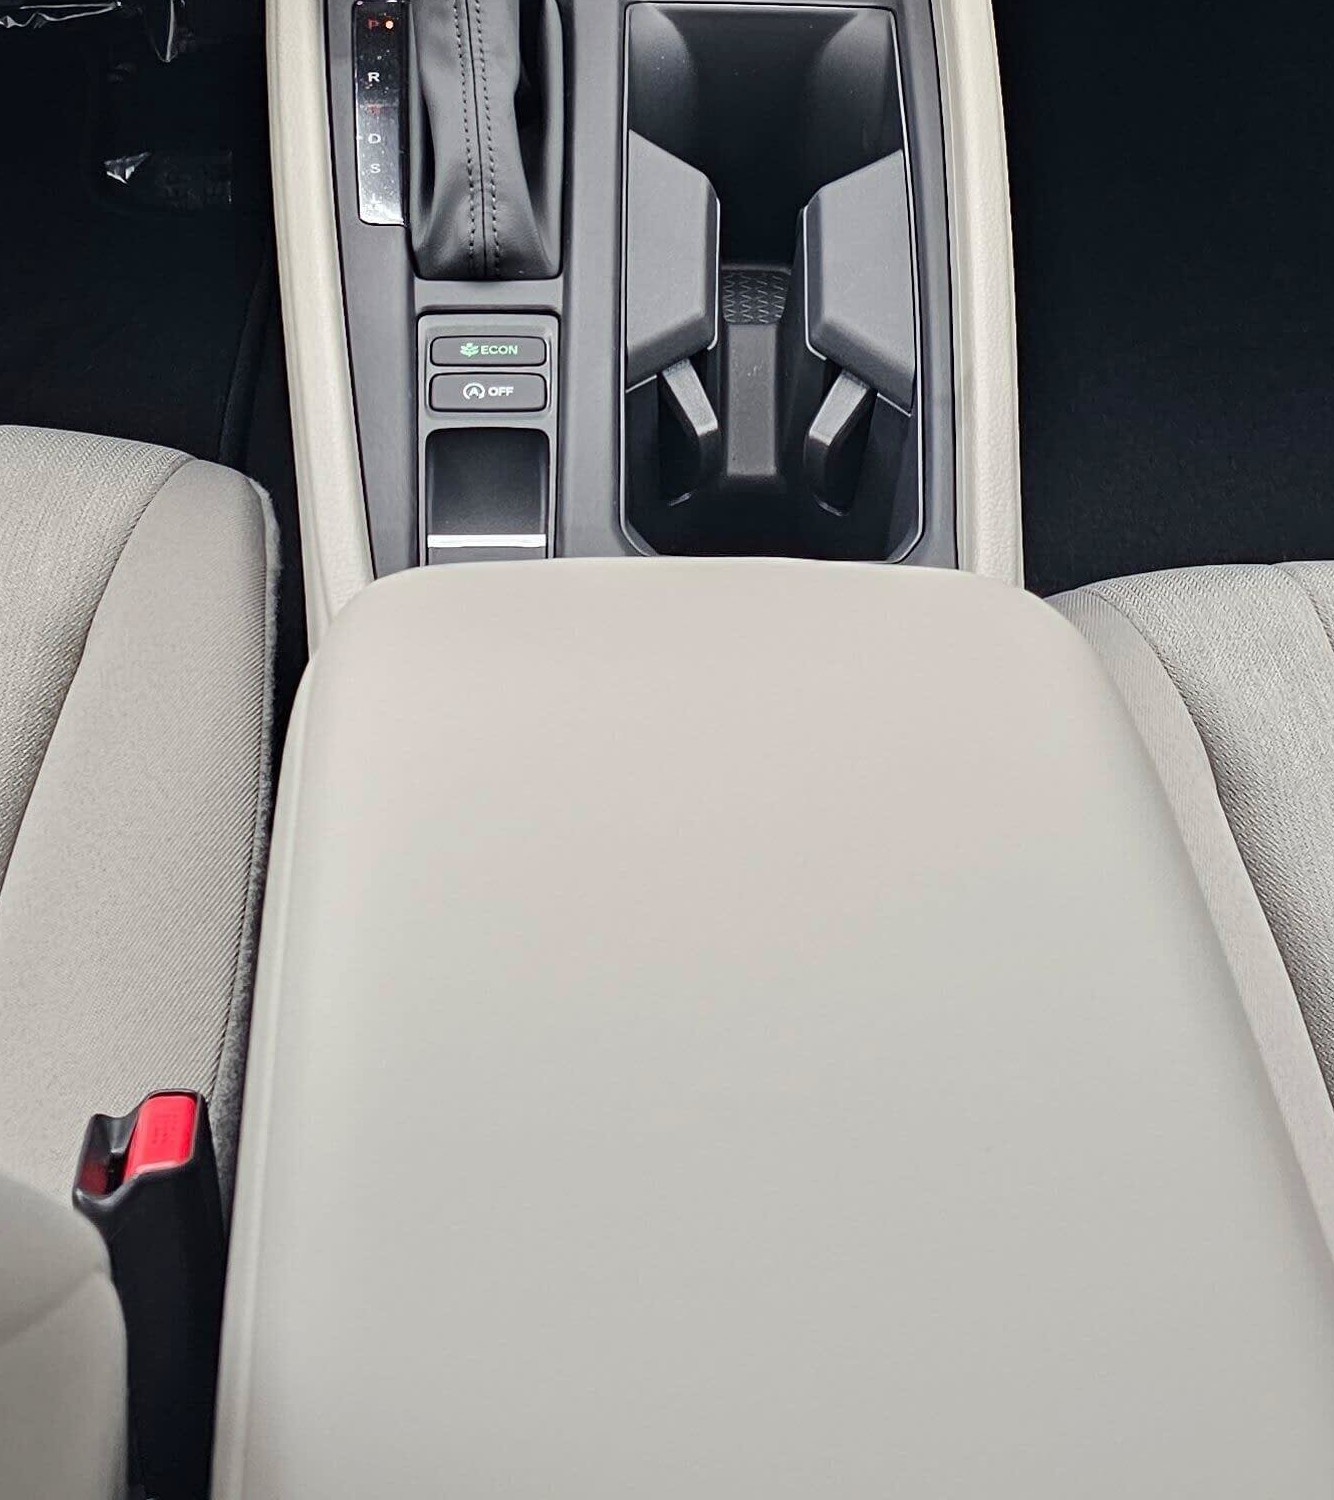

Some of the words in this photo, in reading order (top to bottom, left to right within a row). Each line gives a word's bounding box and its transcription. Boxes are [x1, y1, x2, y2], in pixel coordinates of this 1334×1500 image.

[368, 19, 380, 29] P
[367, 72, 380, 82] R
[368, 133, 381, 144] D
[370, 163, 381, 173] S
[480, 345, 518, 355] ECON
[488, 386, 514, 397] OFF
